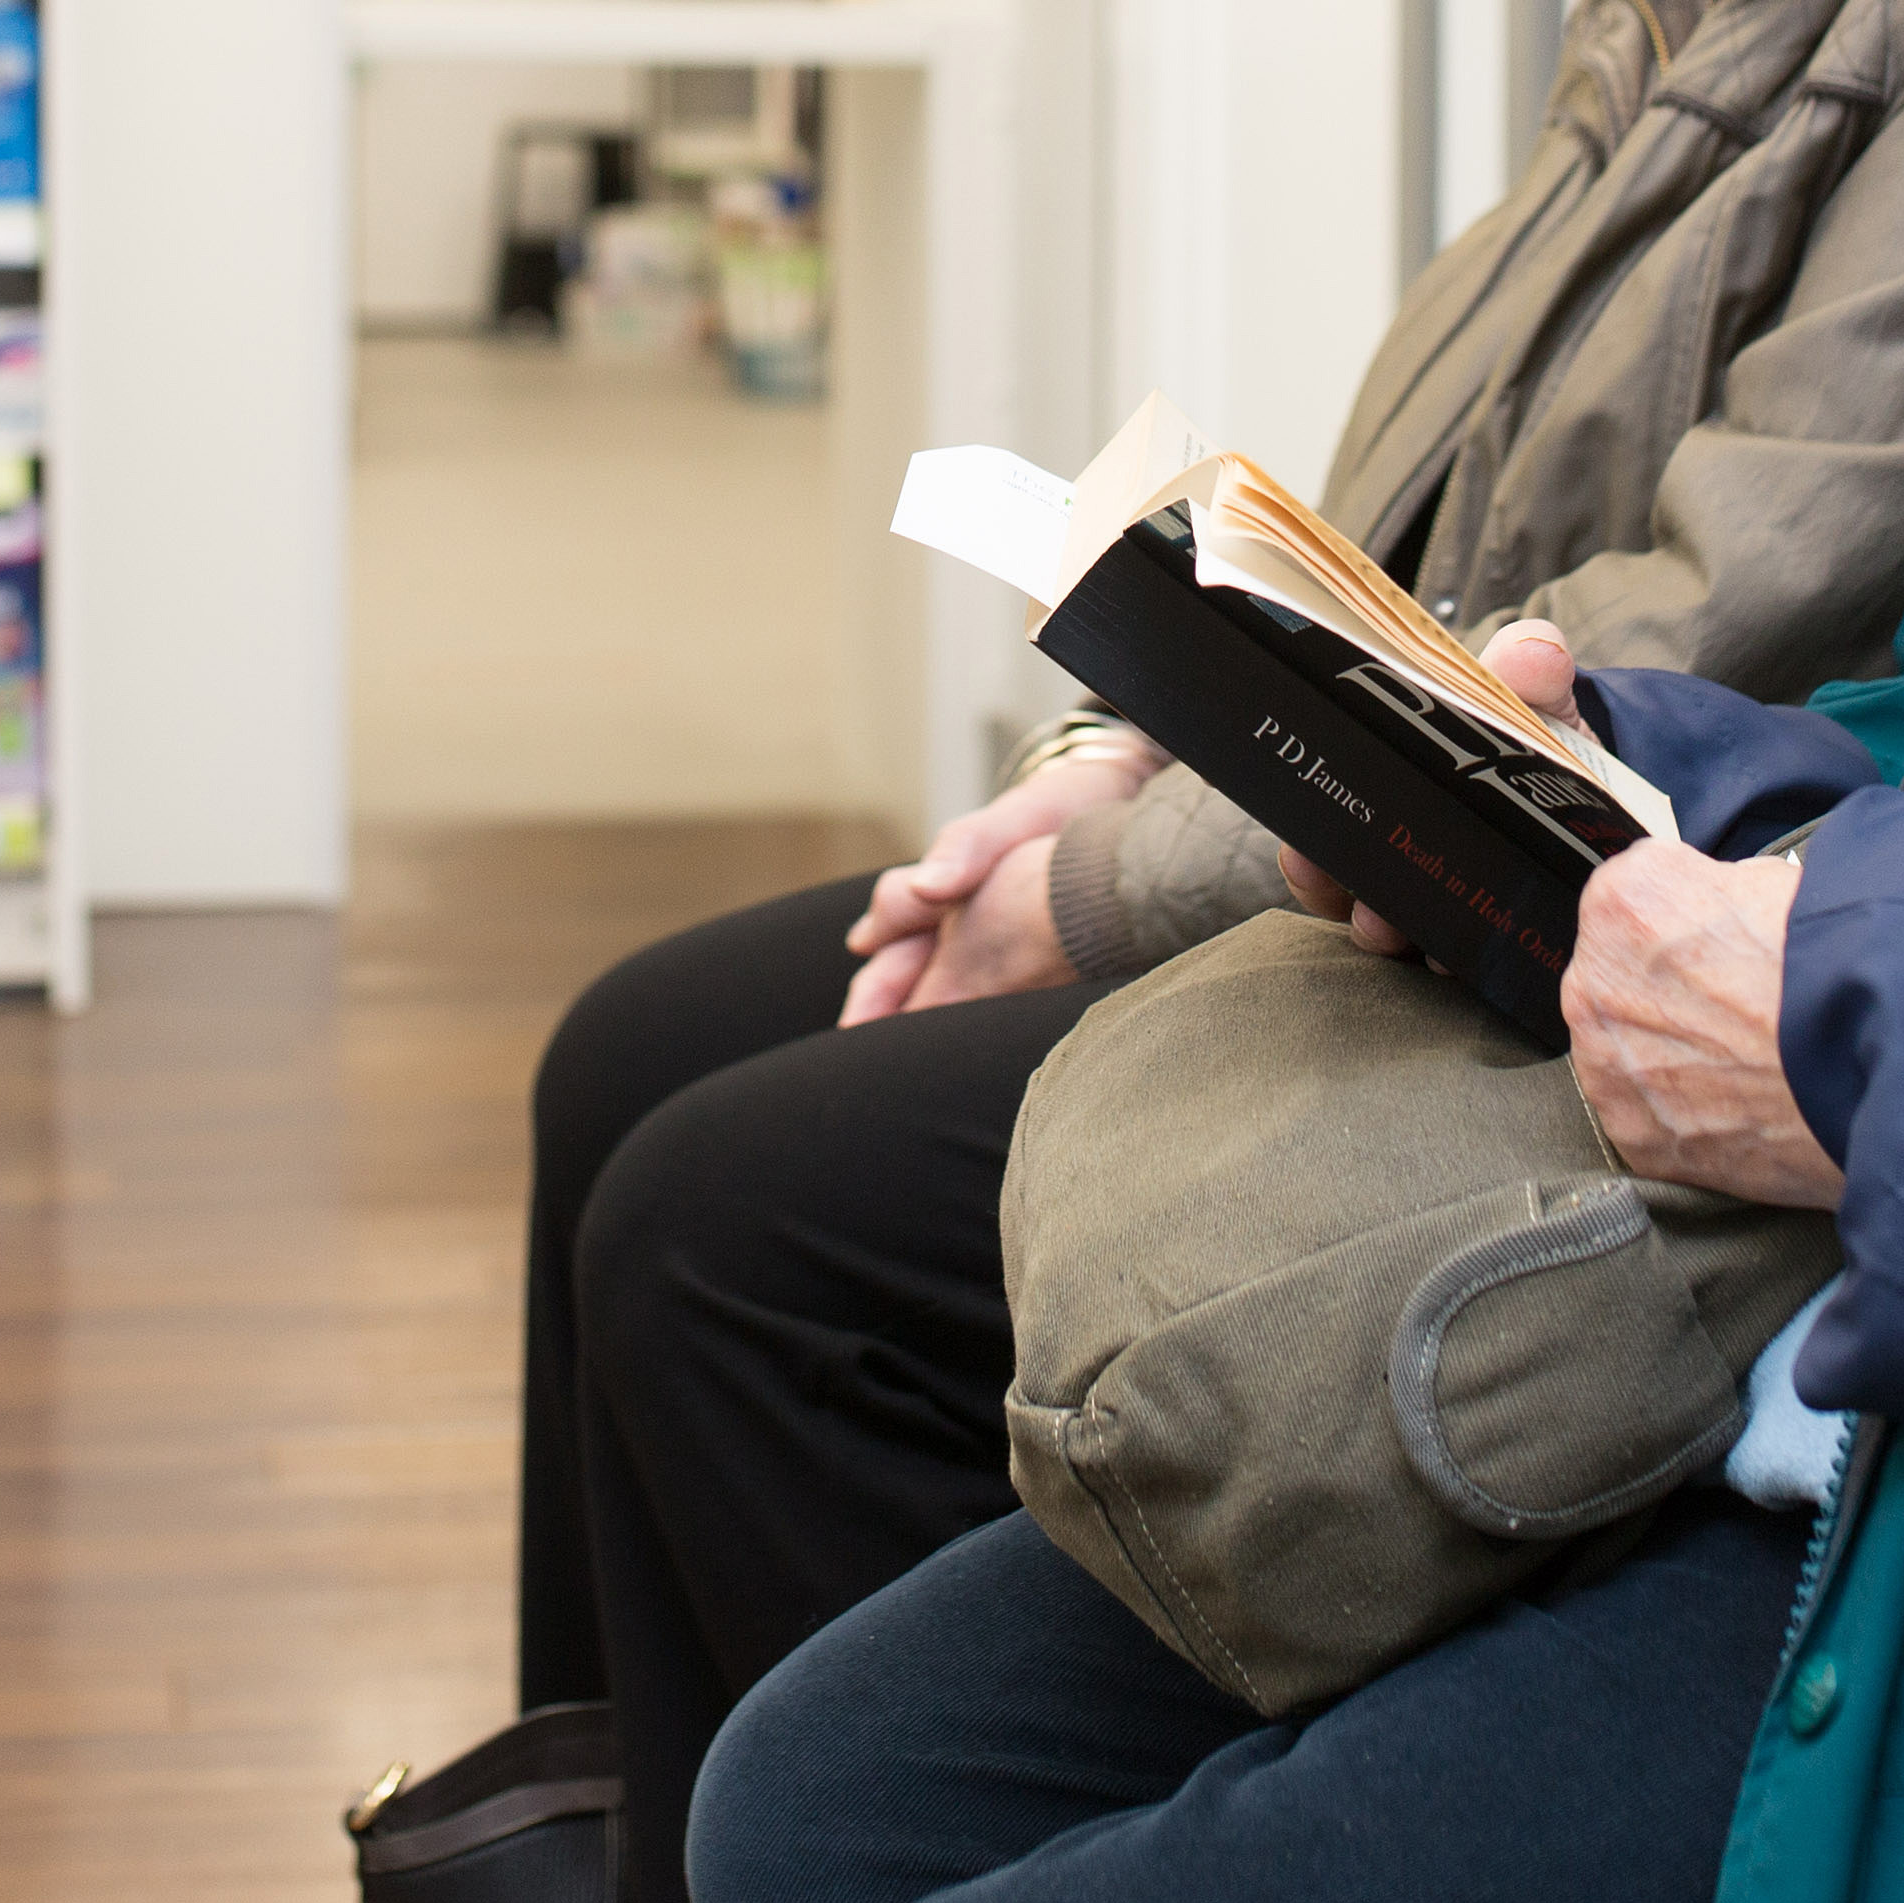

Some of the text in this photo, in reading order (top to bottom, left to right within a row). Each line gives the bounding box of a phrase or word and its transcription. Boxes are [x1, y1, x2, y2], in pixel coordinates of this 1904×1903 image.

[1253, 714, 1280, 741] P
[1276, 733, 1306, 765] D
[1297, 755, 1376, 824] James
[1388, 823, 1446, 880] Death
